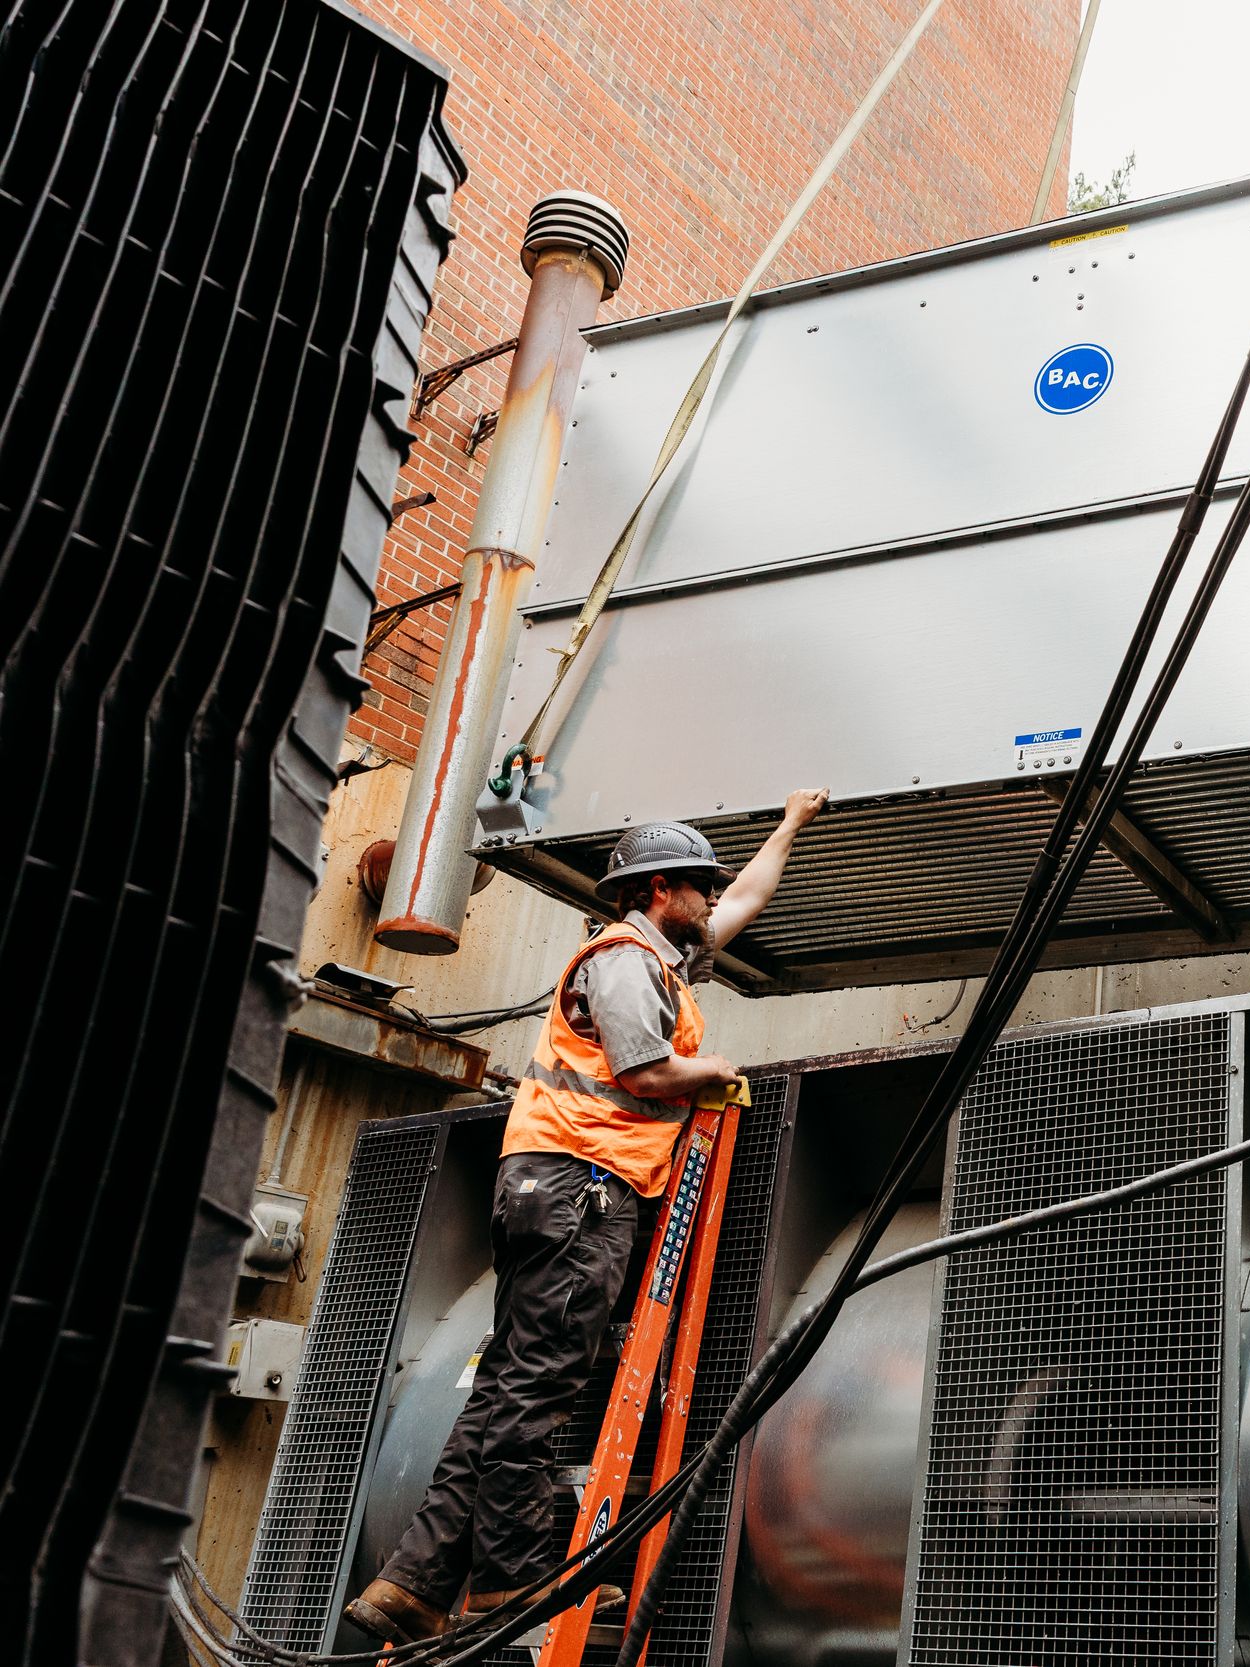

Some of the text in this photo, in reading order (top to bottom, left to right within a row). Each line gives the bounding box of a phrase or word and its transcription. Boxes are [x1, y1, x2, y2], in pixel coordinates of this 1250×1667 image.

[1099, 226, 1126, 237] CAUTION
[1061, 235, 1087, 245] CAUTION
[1048, 368, 1100, 390] BAC
[1032, 731, 1065, 743] NOTICE
